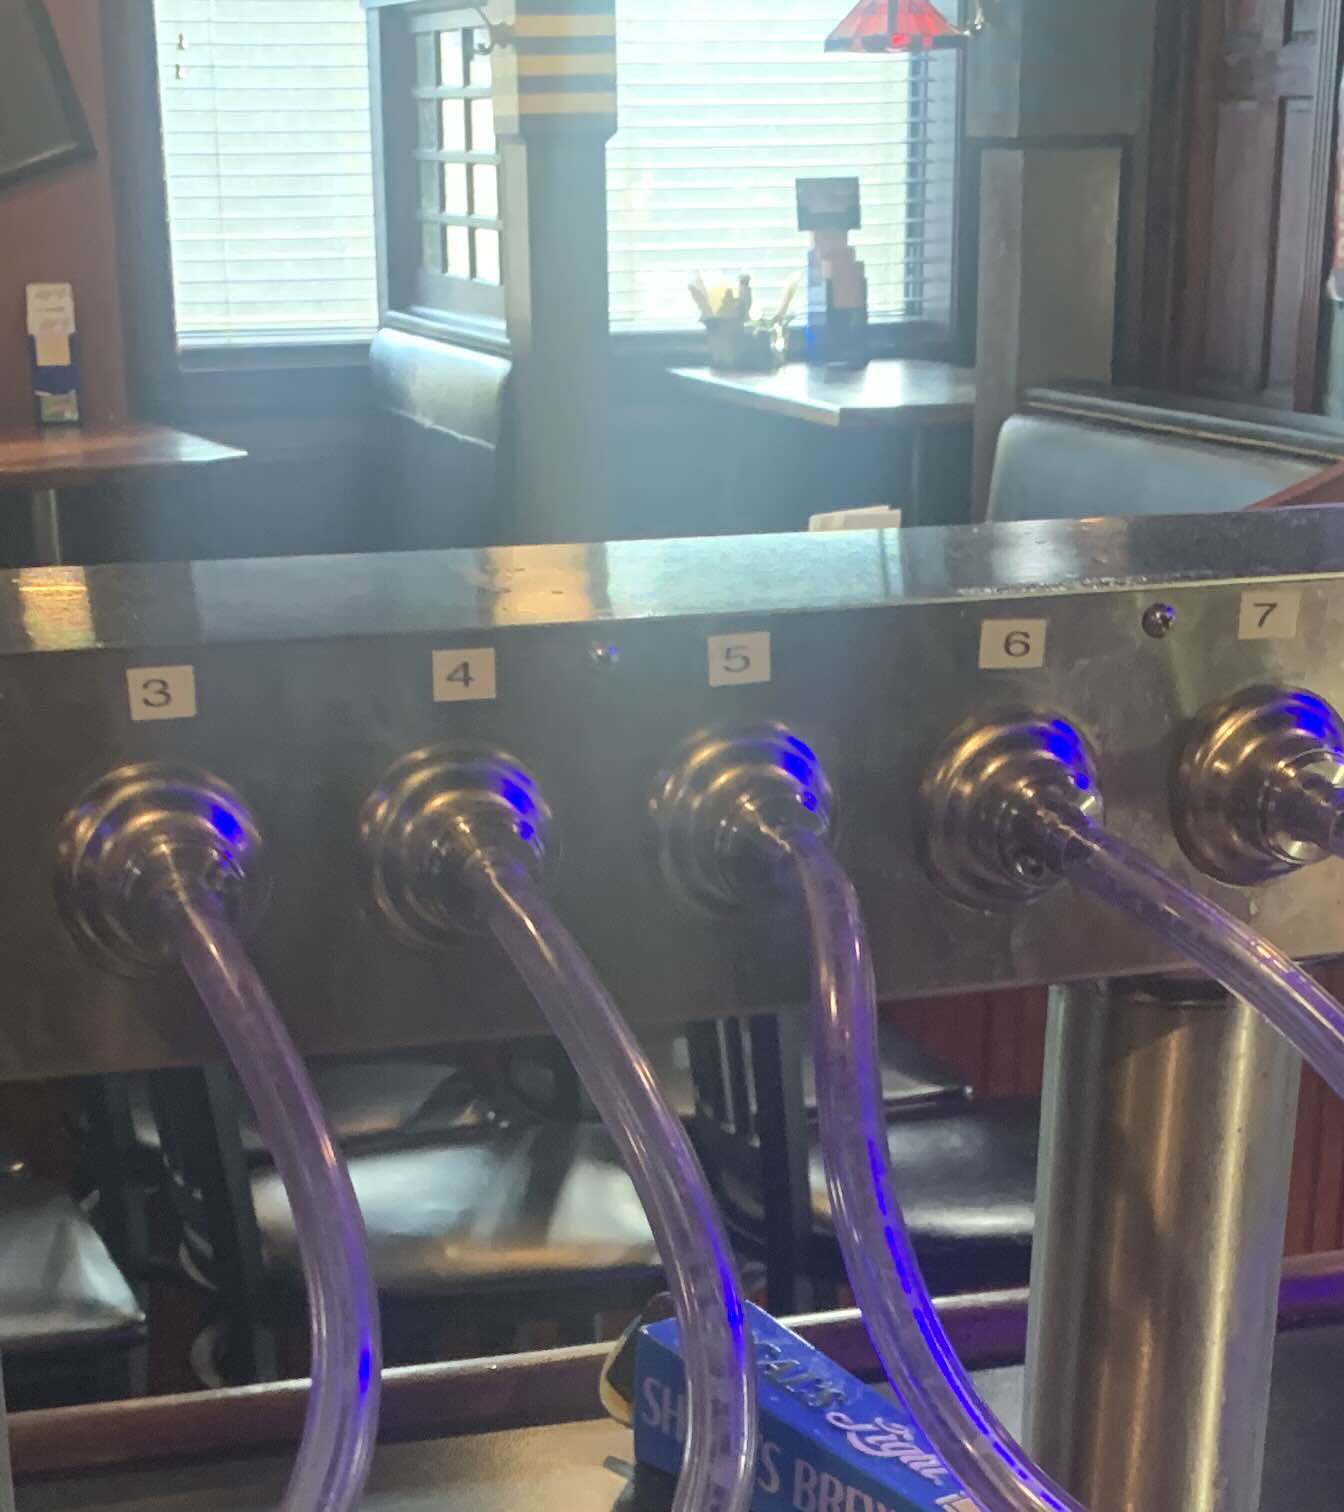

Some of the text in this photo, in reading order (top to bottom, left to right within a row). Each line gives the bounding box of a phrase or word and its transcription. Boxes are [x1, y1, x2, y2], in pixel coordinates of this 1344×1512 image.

[1253, 602, 1278, 629] 7
[1004, 630, 1031, 657] 6
[722, 645, 751, 673] 5
[446, 660, 475, 688] 4
[141, 678, 171, 708] 3
